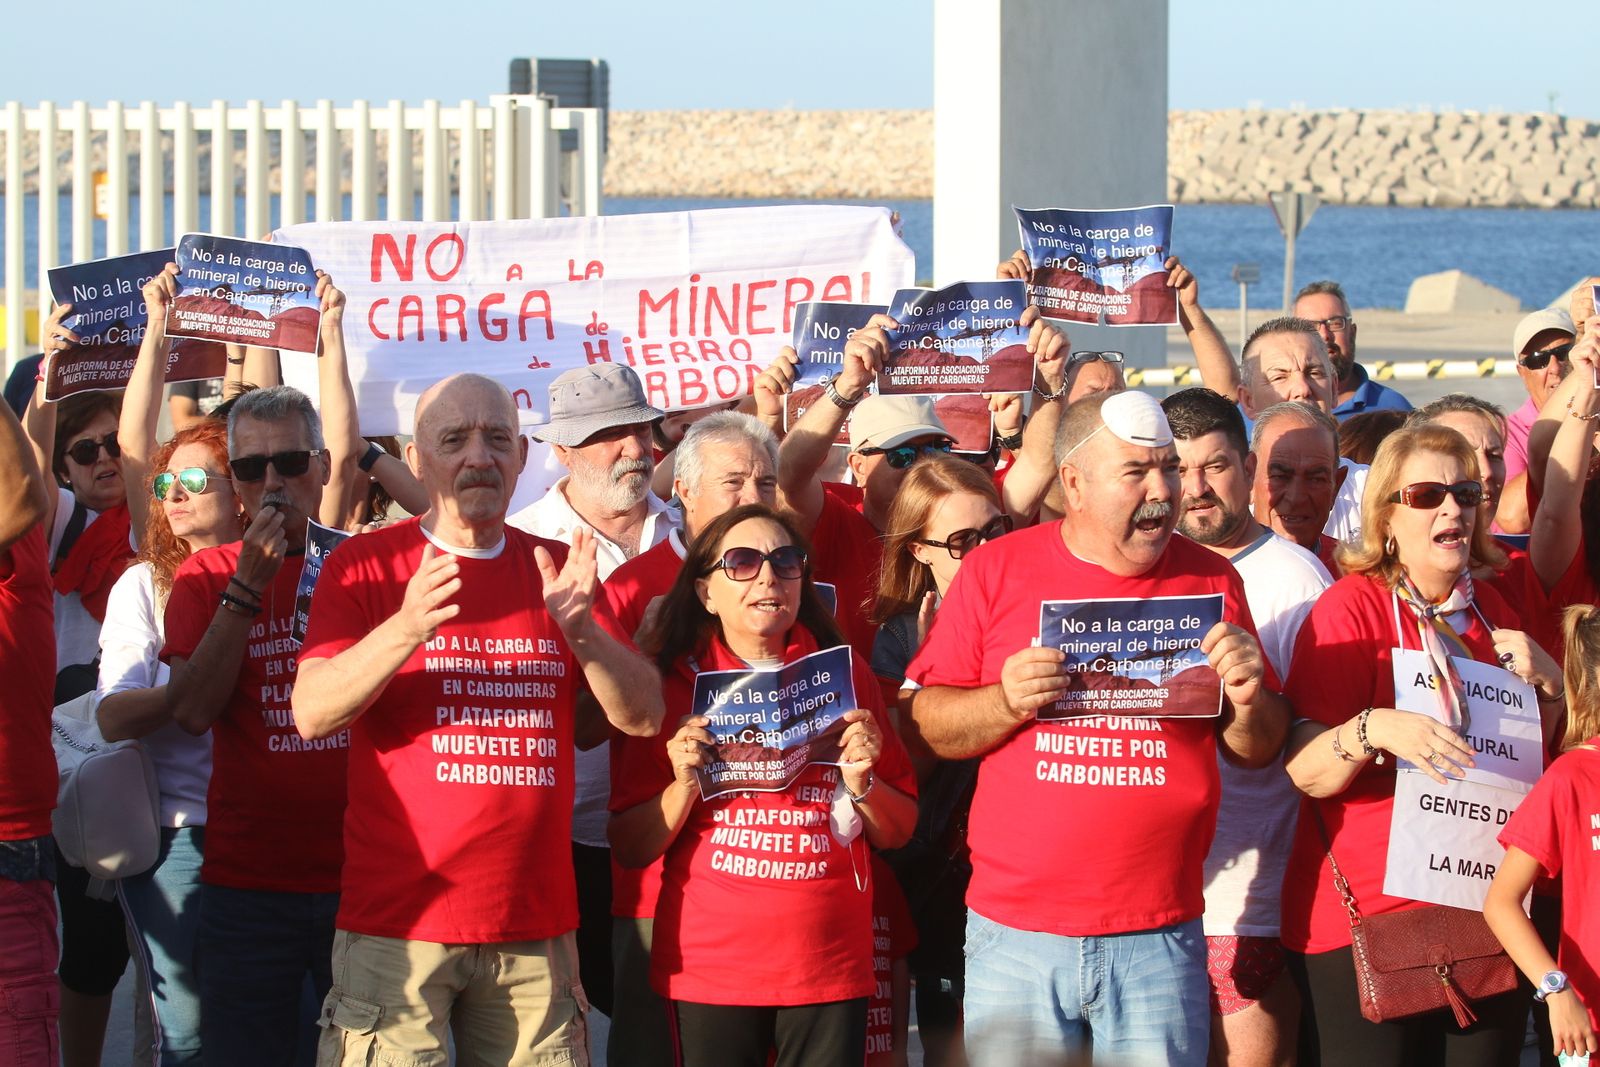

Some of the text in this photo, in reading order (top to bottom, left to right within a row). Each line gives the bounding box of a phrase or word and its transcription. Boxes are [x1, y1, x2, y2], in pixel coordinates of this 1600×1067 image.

[1032, 221, 1154, 242] No a la carga de
[370, 232, 604, 282] NO A LA
[1038, 235, 1157, 259] mineral de hierro
[191, 248, 307, 275] No a la carga de
[1043, 256, 1149, 275] en Carboneras
[73, 284, 97, 302] No
[102, 283, 113, 297] a
[116, 278, 132, 294] la
[188, 268, 305, 293] mineral de hierro
[193, 287, 296, 307] en Carboneras
[1026, 284, 1132, 304] PLATAFORMA DE ASOCIACIONES
[1030, 295, 1060, 308] MUEVETE
[1061, 299, 1076, 310] POR
[76, 302, 133, 325] mineral
[368, 290, 555, 342] CARGA
[585, 311, 609, 336] de
[902, 296, 1013, 316] No a la carga de
[175, 310, 276, 330] PLATAFORMA DE ASOCIACIONES
[180, 320, 270, 339] MUEVETE POR CARBONERAS
[897, 315, 1015, 333] mineral de hierro
[79, 333, 101, 346] en
[813, 321, 840, 340] No
[899, 335, 1008, 350] en Carboneras
[57, 360, 107, 376] PLATAFORMA
[110, 360, 122, 370] DE
[885, 365, 990, 376] PLATAFORMA DE ASOCIACIONES
[63, 371, 97, 386] MUEVETE
[100, 371, 116, 380] POR
[891, 375, 984, 385] MUEVETE POR CARBONERAS
[511, 388, 533, 409] n
[310, 539, 321, 558] No
[1061, 614, 1201, 634] No a la carga de
[425, 636, 560, 655] NO A LA CARGA DEL
[1060, 636, 1201, 654] mineral de hierro
[266, 660, 283, 676] EN
[425, 657, 565, 677] MINERAL DE HIERRO
[1067, 657, 1190, 674] en Carboneras
[443, 679, 556, 698] EN CARBONERAS
[707, 671, 831, 705] No a la carga de
[1100, 689, 1111, 699] DE
[1112, 688, 1169, 699] ASOCIACIONES
[1414, 672, 1523, 709] ASIACION
[710, 691, 835, 727] mineral de hierro
[1055, 699, 1163, 710] MUEVETE POR CARBONERAS
[436, 706, 554, 729] PLATAFORMA
[717, 713, 831, 744] en Carboneras
[432, 734, 557, 757] MUEVETE POR
[1035, 732, 1167, 759] MUEVETE POR
[436, 762, 555, 787] CARBONERAS
[703, 761, 753, 775] PLATAFORMA
[754, 761, 765, 771] DE
[711, 771, 747, 783] MUEVETE
[749, 771, 765, 780] POR
[1036, 760, 1166, 786] CARBONERAS
[1419, 793, 1515, 825] GENTES D
[710, 828, 831, 854] MUEVETE POR
[711, 850, 827, 880] CARBONERAS
[1429, 853, 1451, 873] LA
